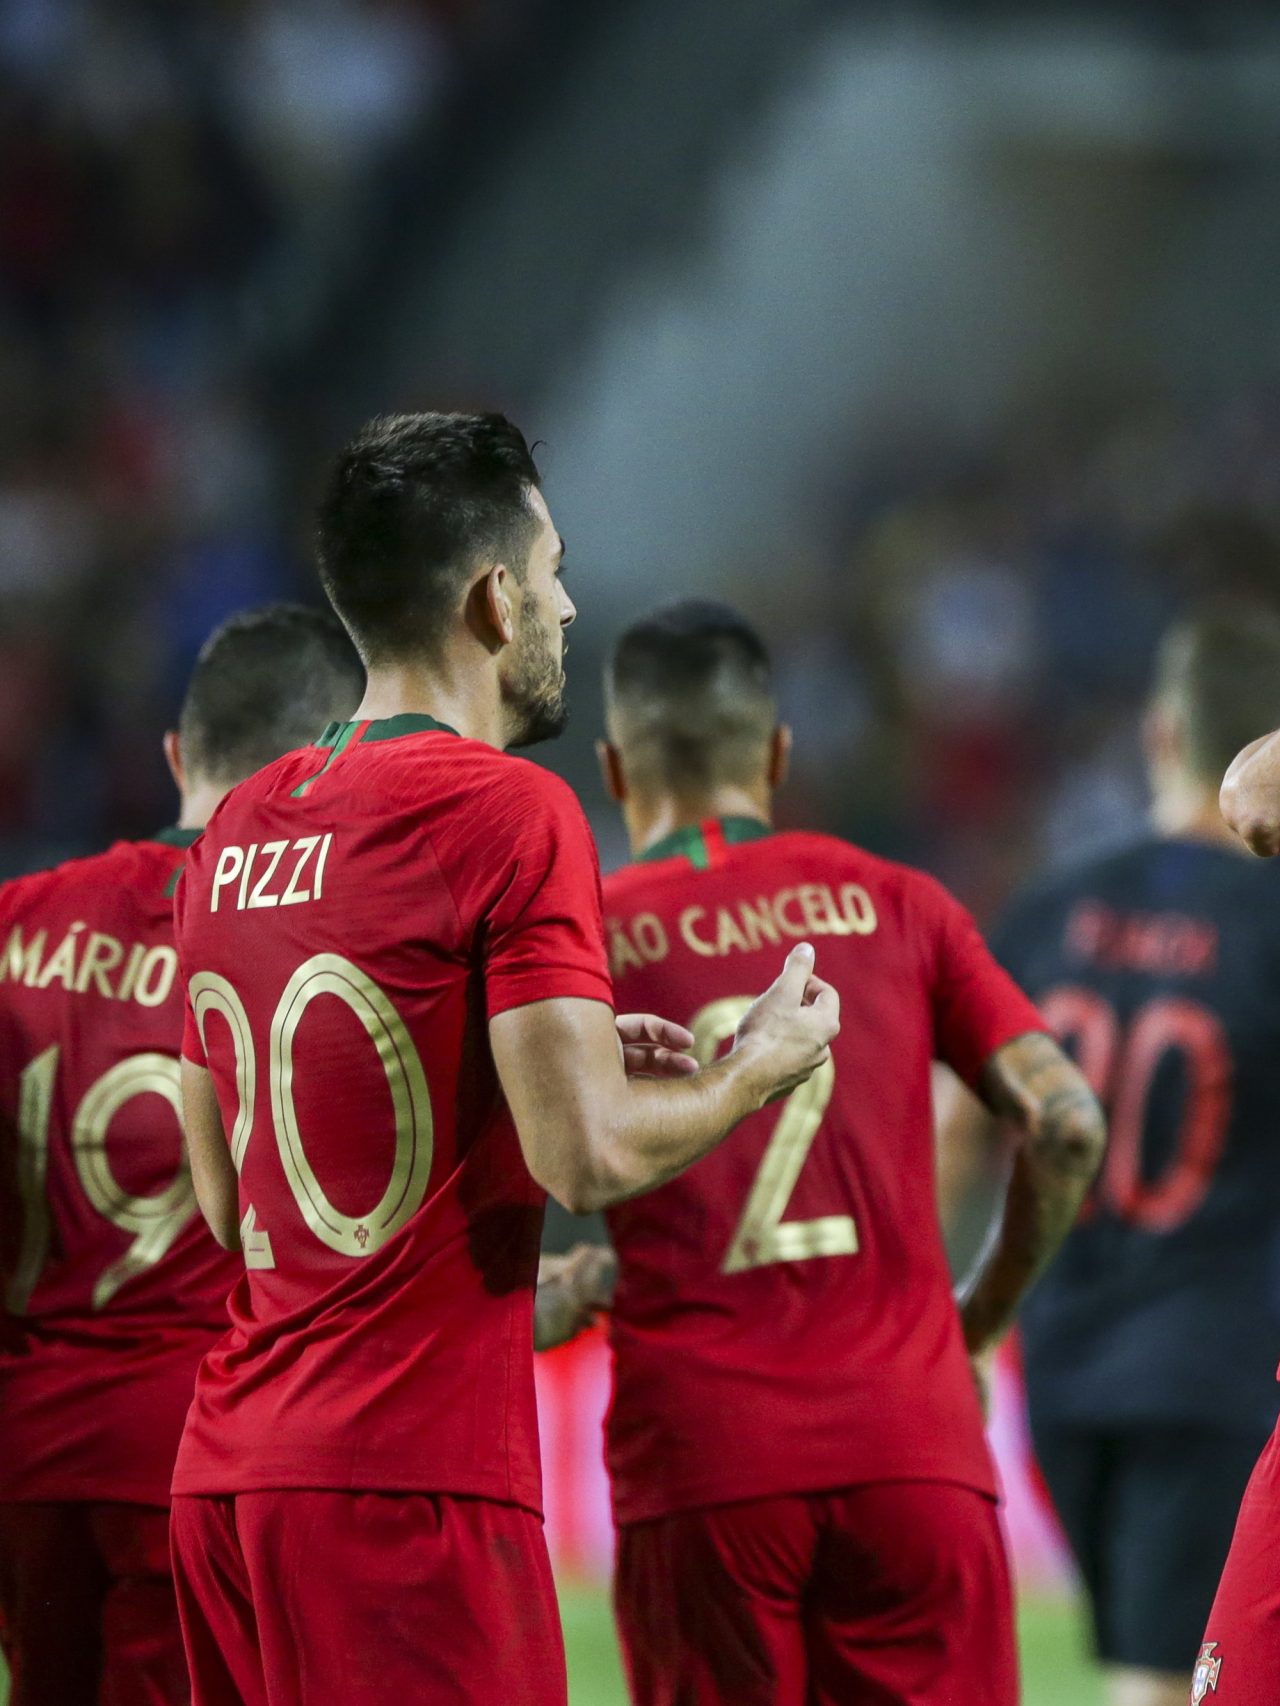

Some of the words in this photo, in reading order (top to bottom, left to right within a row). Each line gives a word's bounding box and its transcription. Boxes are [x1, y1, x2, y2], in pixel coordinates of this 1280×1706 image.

[210, 833, 333, 912] PIZZI
[678, 882, 878, 957] CANCELO
[0, 920, 178, 1007] MÁRIO
[690, 995, 858, 1276] 2
[8, 1045, 200, 1314] 19
